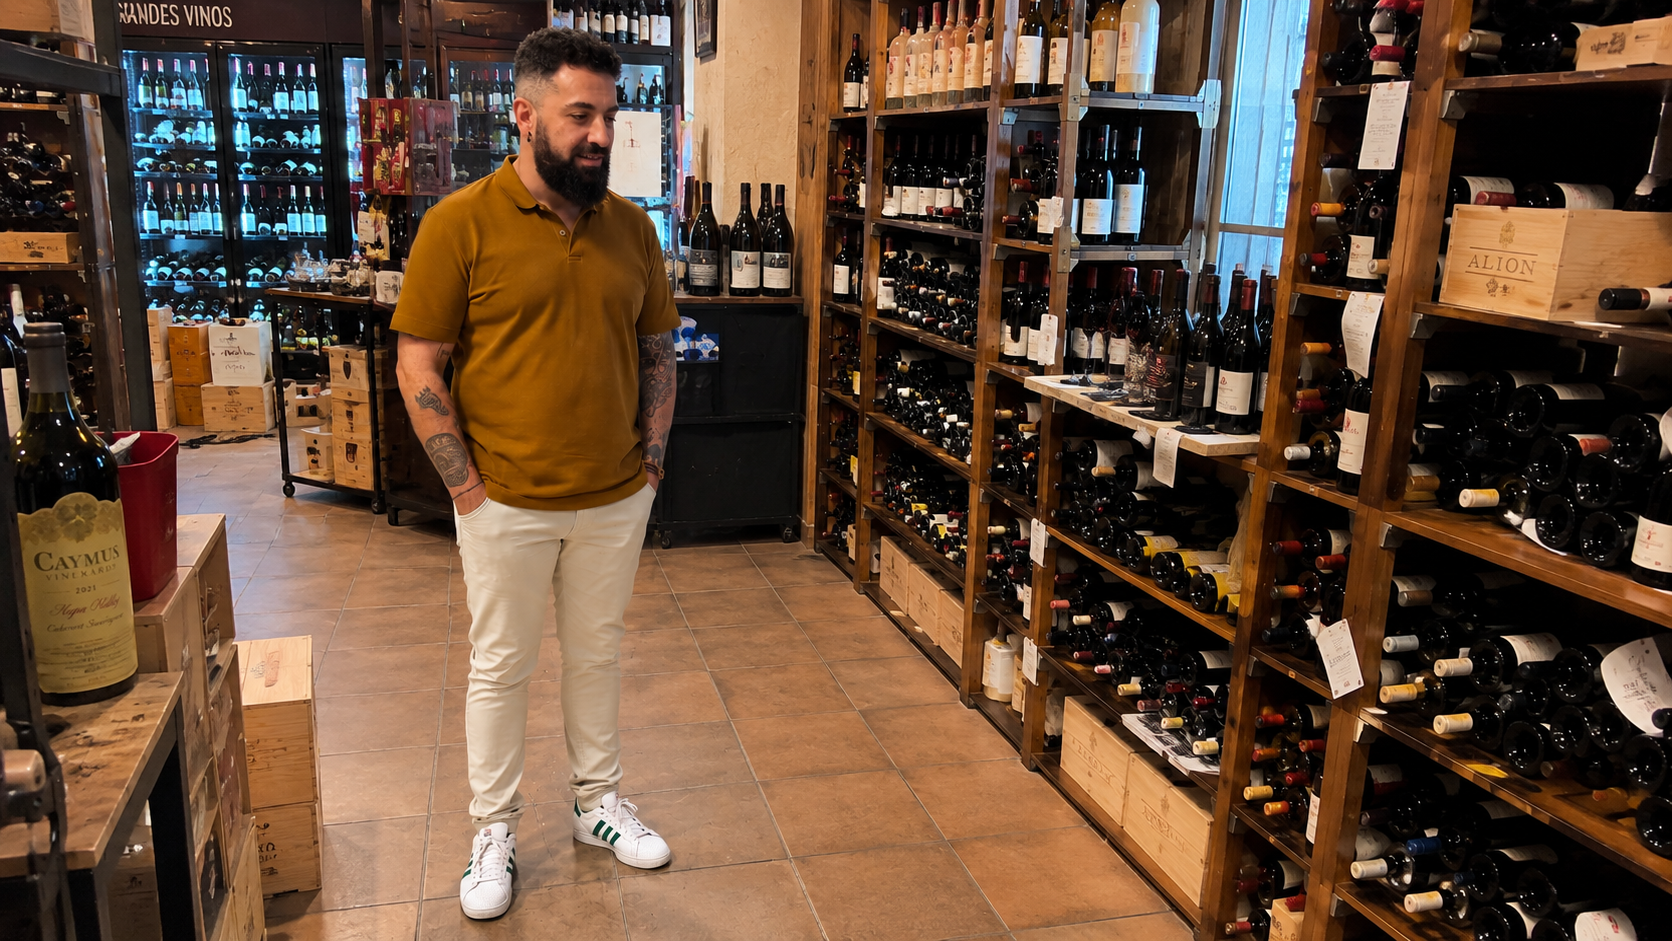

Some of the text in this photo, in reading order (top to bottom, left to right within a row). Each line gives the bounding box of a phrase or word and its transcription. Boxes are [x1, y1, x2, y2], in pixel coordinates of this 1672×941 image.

[183, 4, 233, 28] VINOS
[1467, 254, 1537, 275] ALION
[33, 544, 120, 572] CAYMUS
[75, 585, 97, 595] 2021
